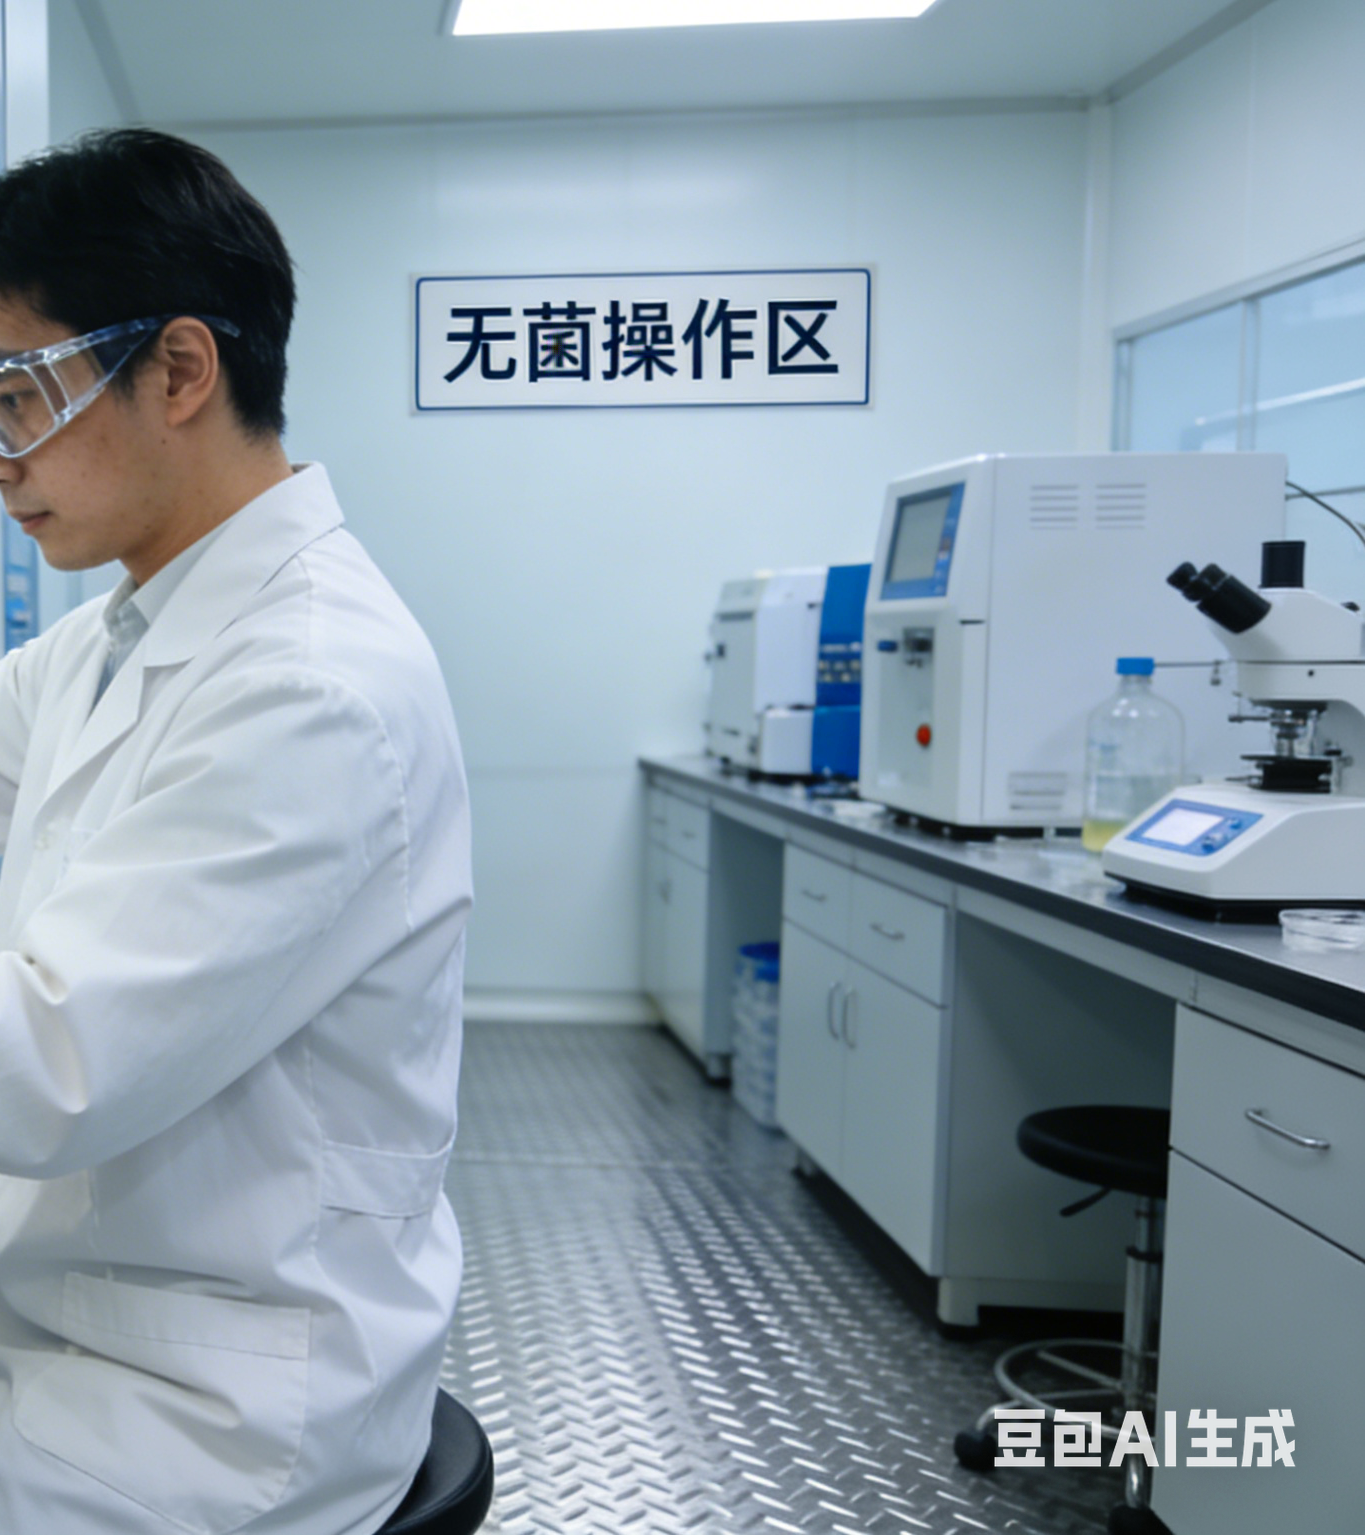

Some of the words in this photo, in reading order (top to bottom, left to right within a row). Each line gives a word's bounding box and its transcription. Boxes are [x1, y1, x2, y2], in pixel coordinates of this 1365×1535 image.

[443, 298, 839, 383] 无菌操作区
